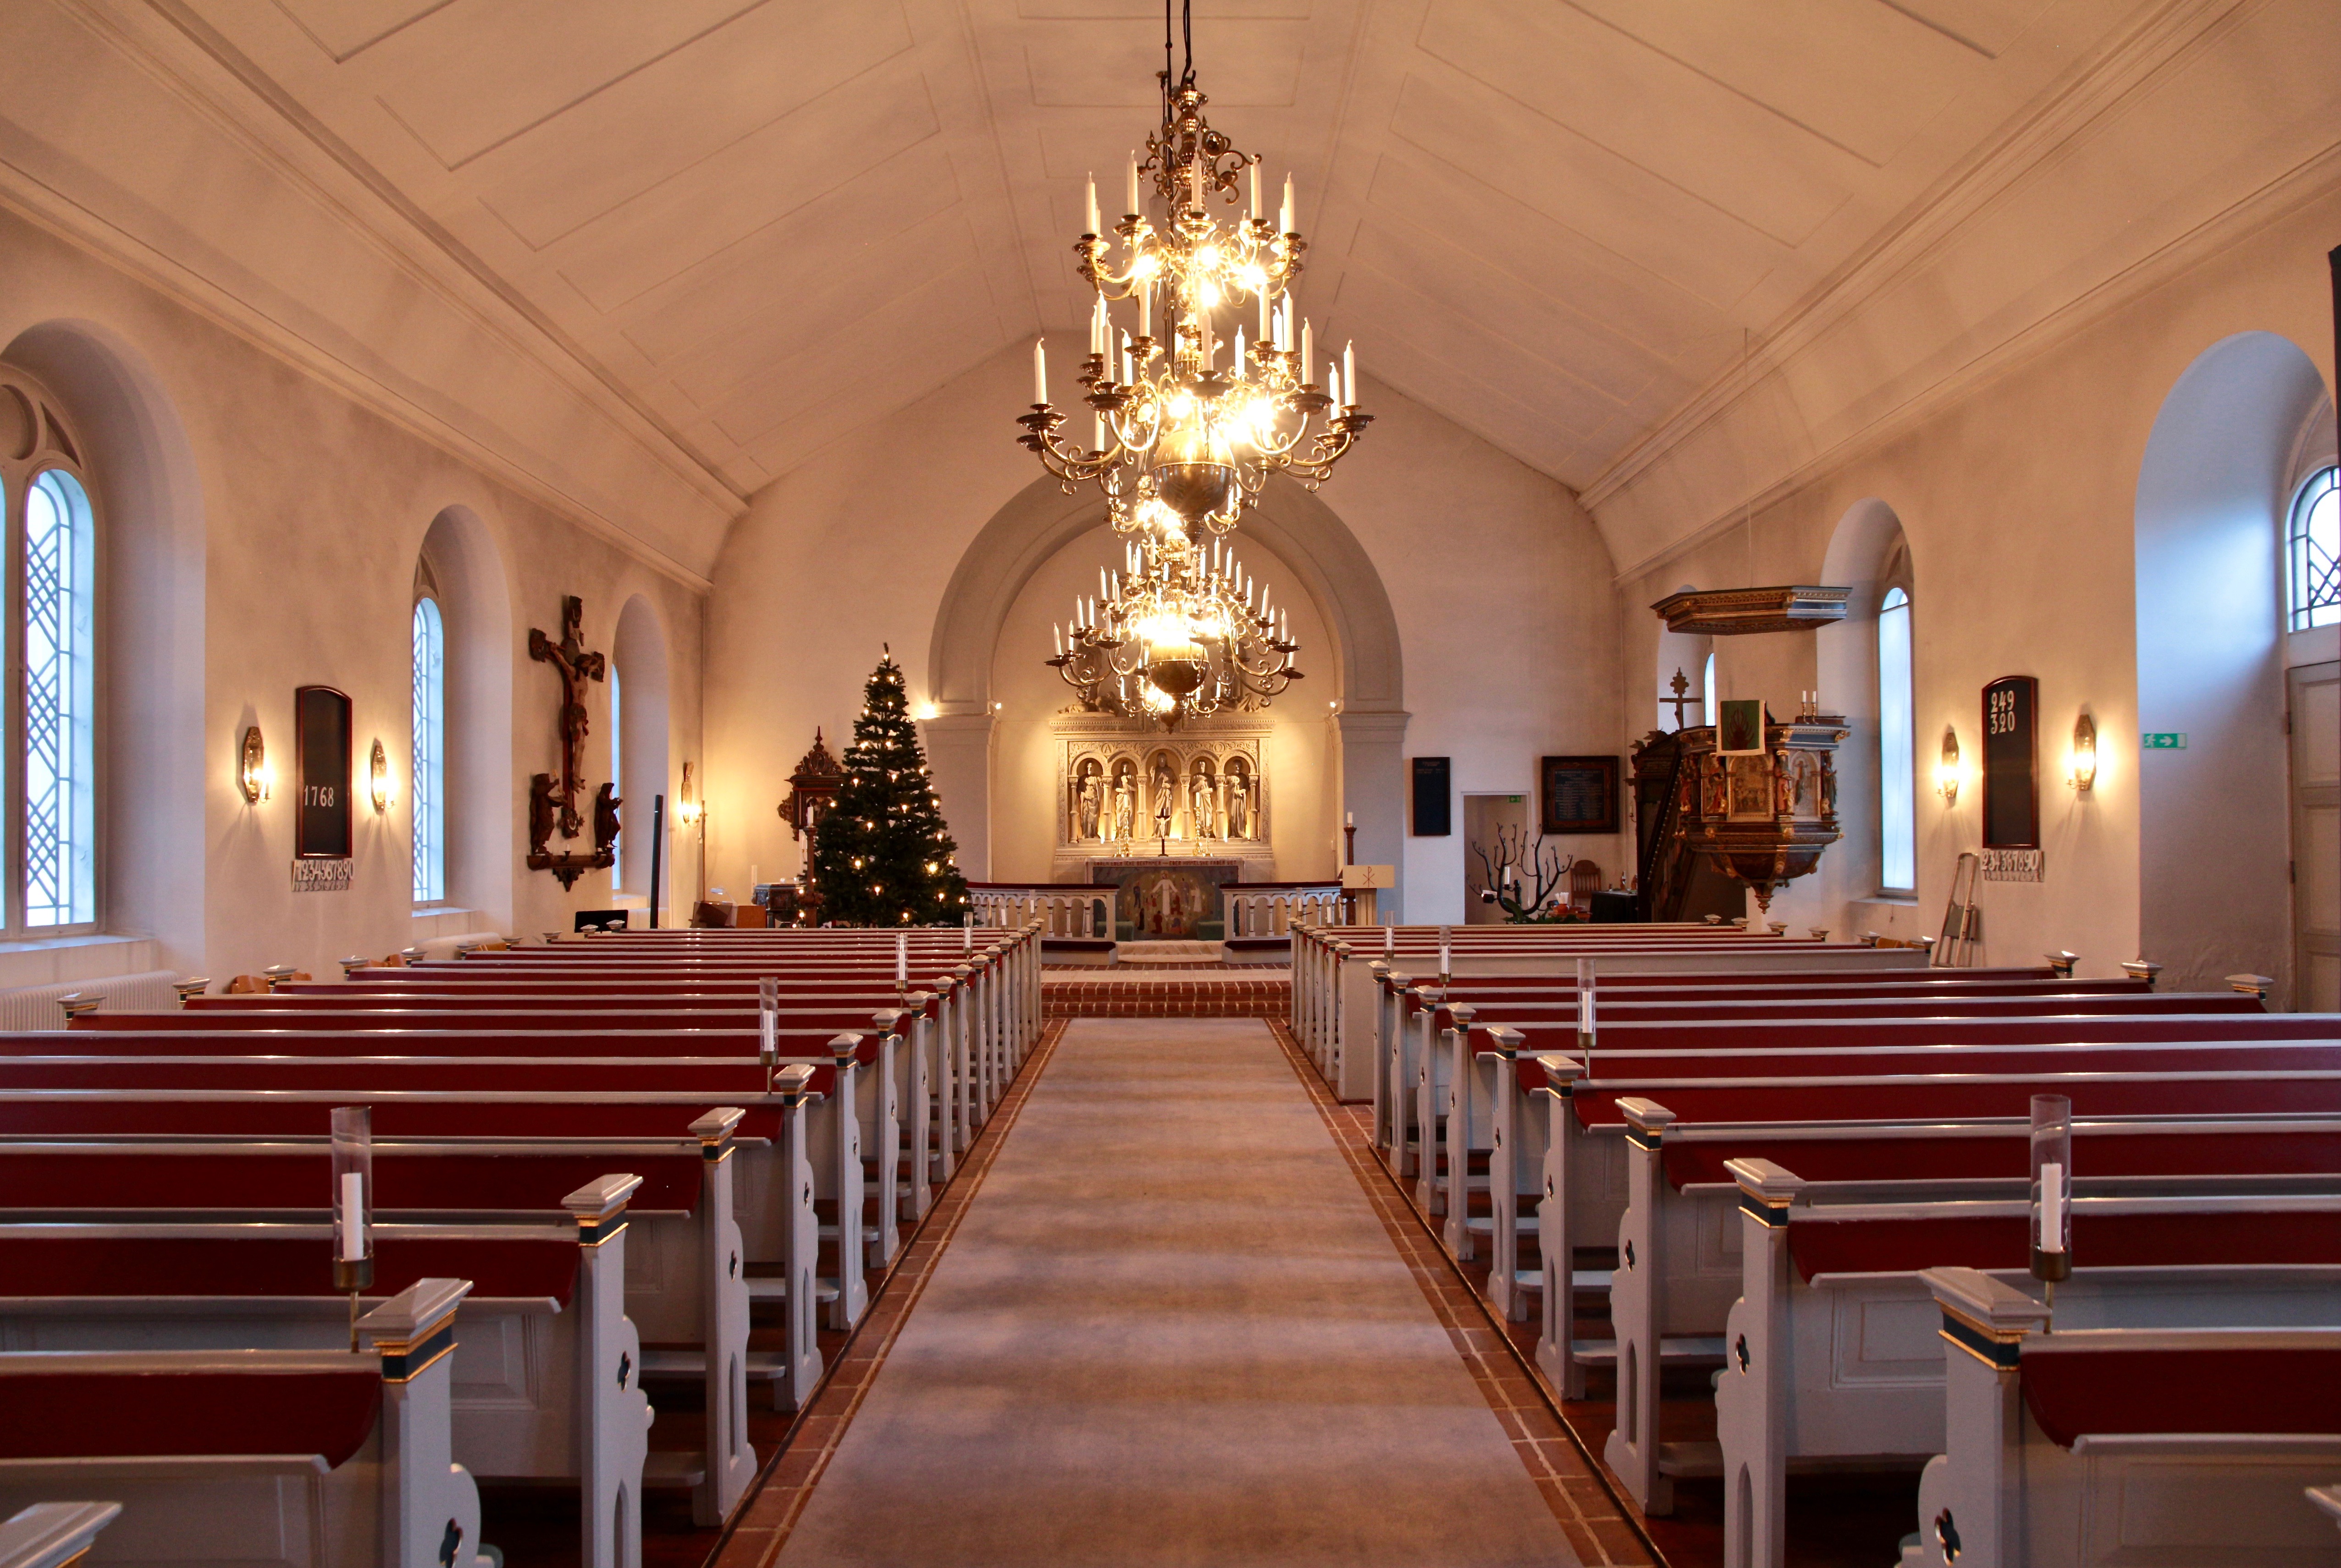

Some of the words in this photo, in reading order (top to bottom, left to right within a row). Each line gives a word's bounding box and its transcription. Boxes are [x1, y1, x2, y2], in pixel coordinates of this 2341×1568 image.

[1991, 690, 2015, 713] 249
[1990, 711, 2015, 734] 320
[304, 785, 334, 807] 1768
